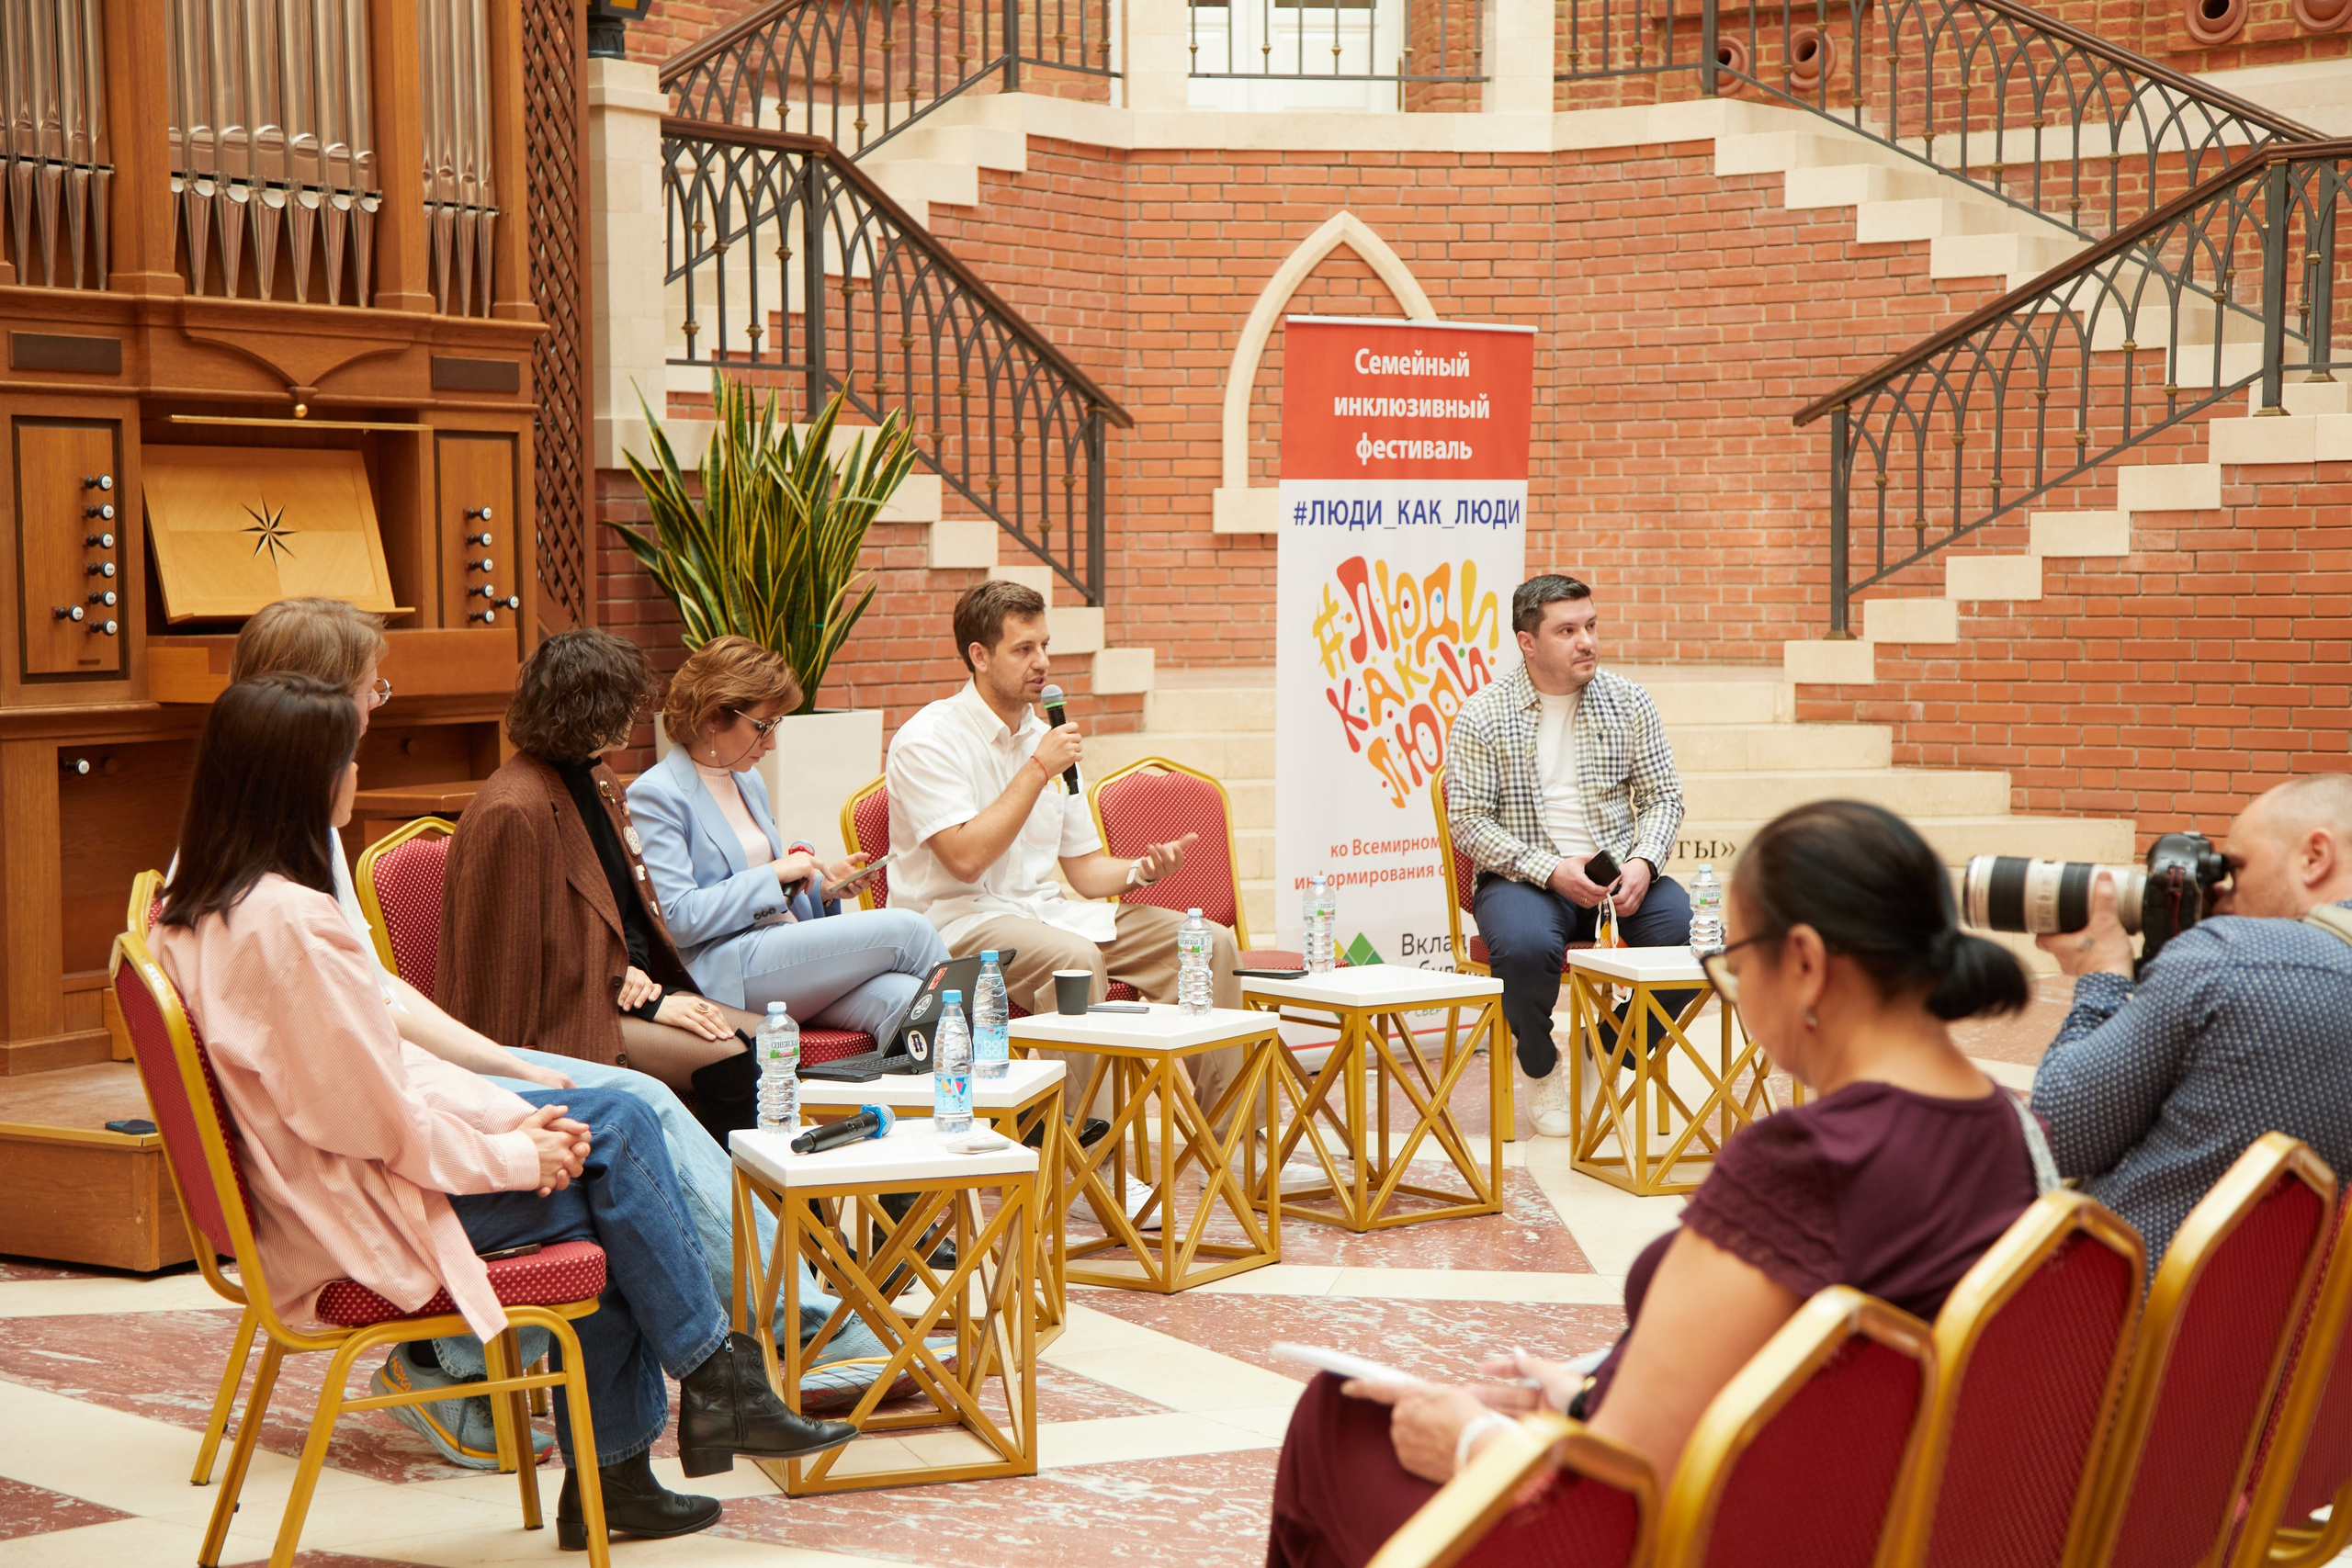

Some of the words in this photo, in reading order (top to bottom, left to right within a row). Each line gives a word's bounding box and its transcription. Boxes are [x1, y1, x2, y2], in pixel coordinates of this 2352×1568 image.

[1354, 348, 1470, 378] Семейный
[1334, 393, 1490, 419] инклюзивный
[1355, 432, 1473, 466] фестиваль
[1294, 499, 1520, 531] #ЛЮДИ_КАК_ЛЮДИ
[1330, 844, 1348, 858] ко
[1295, 864, 1434, 891] инормирования
